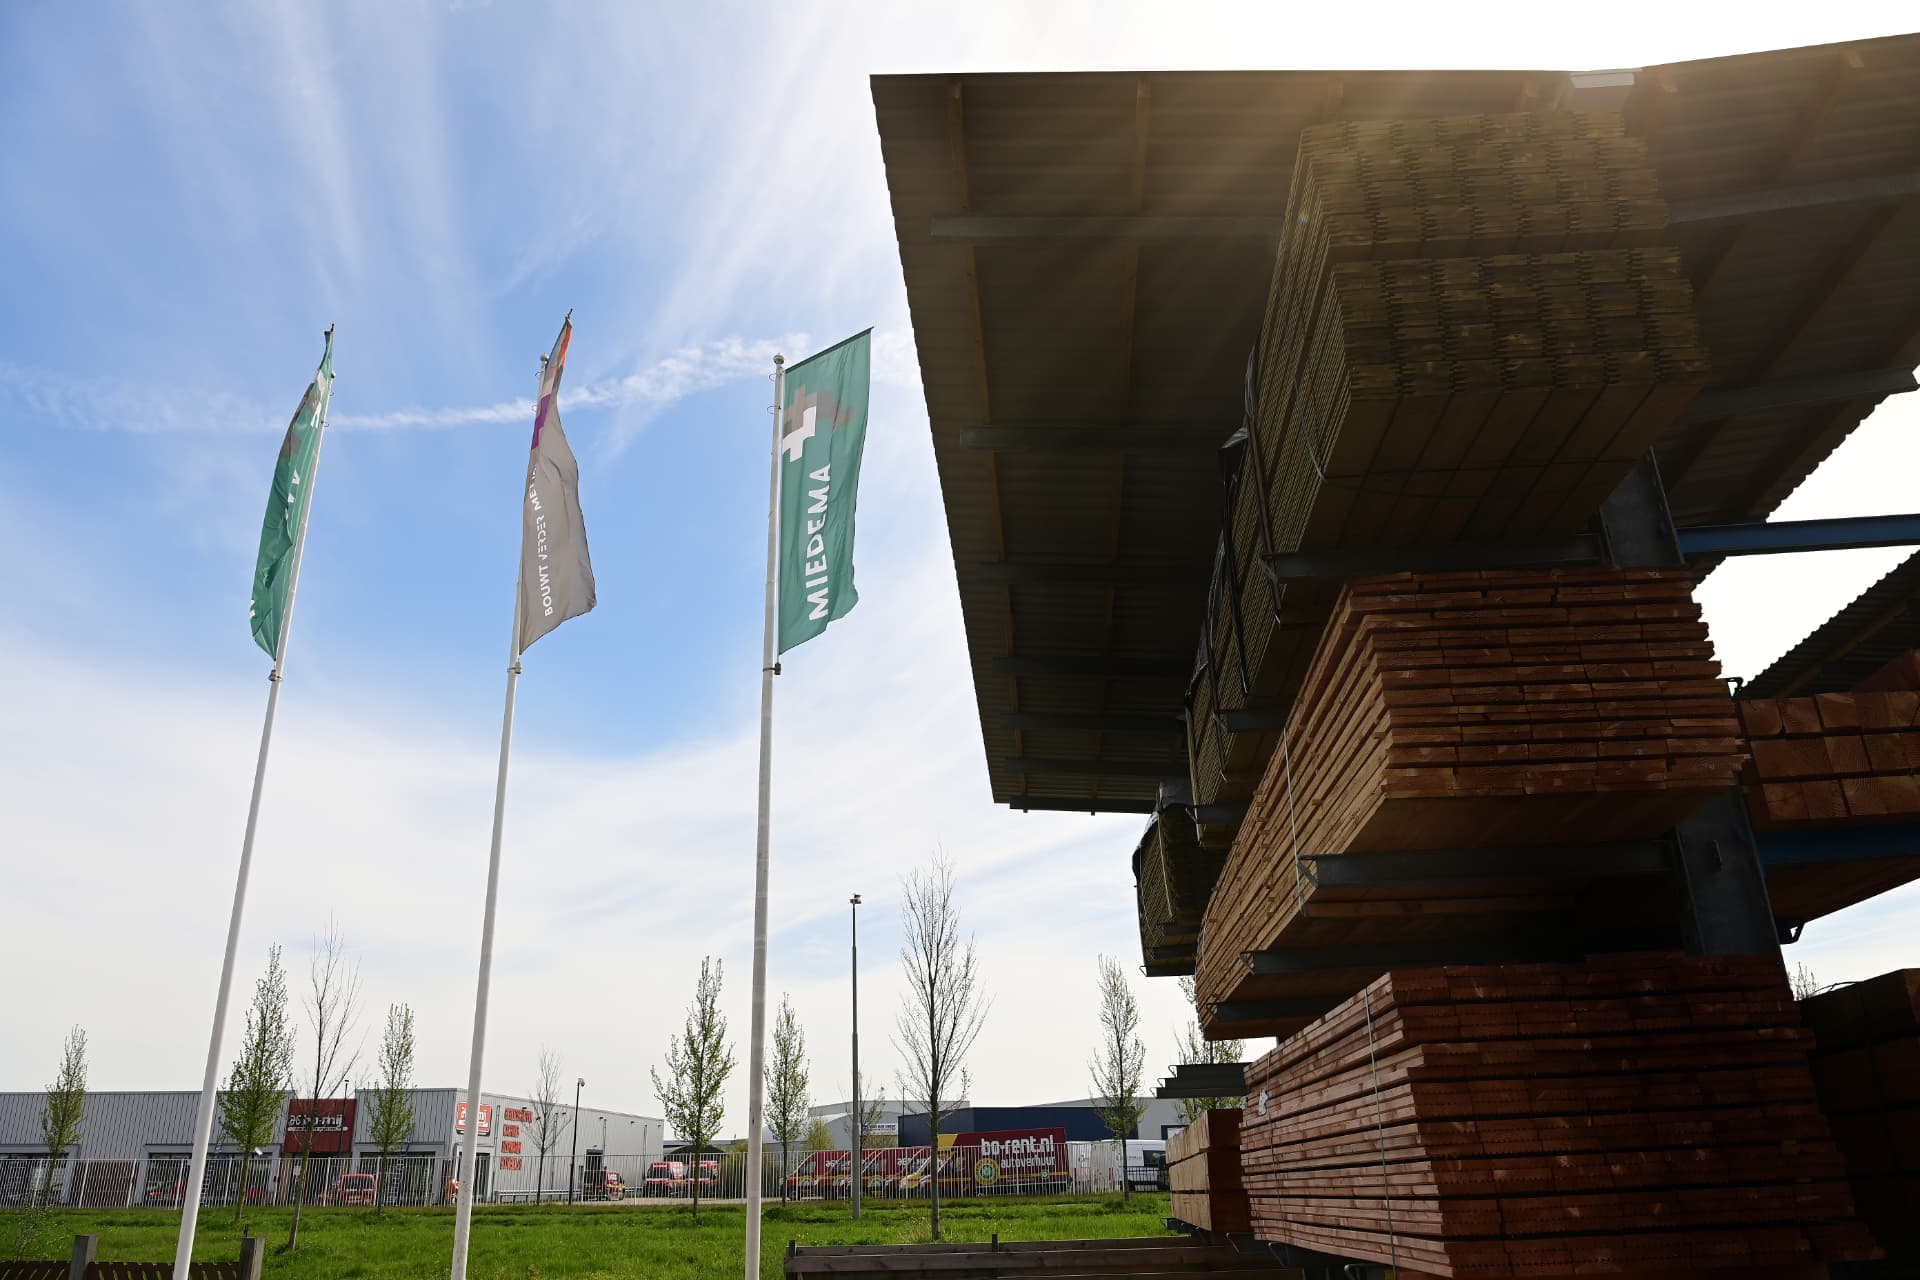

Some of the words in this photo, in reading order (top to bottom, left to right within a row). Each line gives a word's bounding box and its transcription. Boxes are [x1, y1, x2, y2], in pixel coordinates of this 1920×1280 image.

[536, 514, 548, 561] VERDER
[805, 463, 831, 621] MIEDEMA
[538, 565, 553, 617] BOUWT
[1000, 1155, 1056, 1169] autoverhuur
